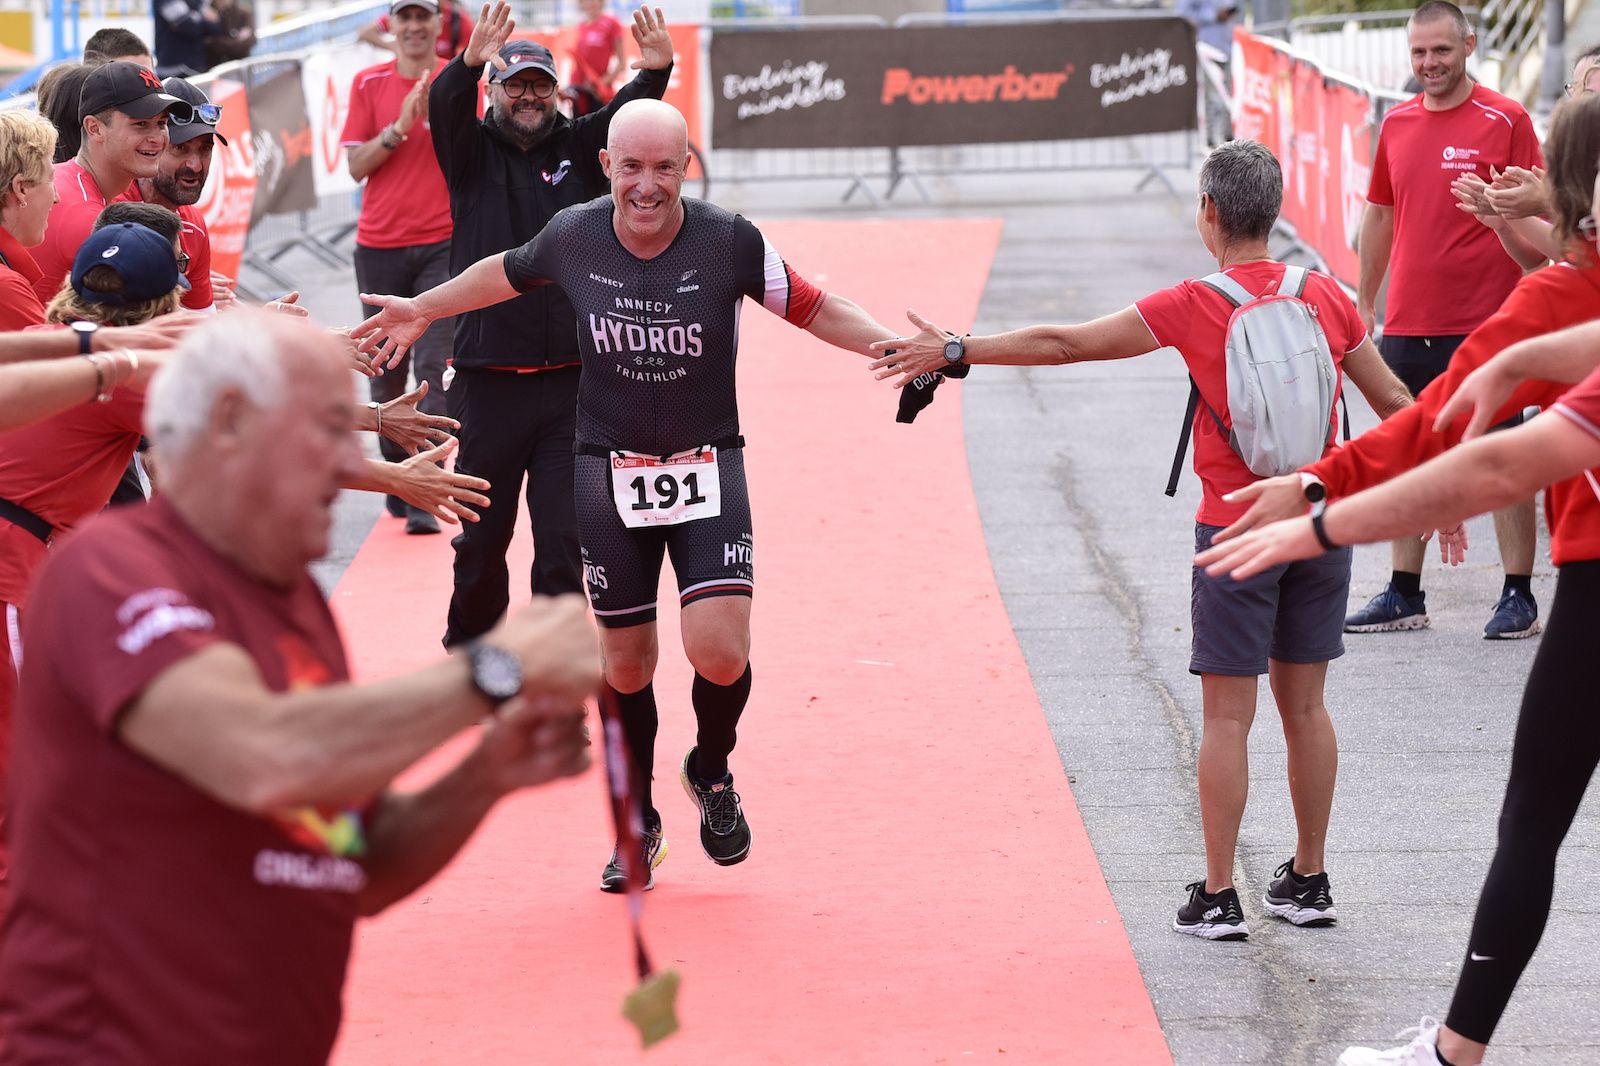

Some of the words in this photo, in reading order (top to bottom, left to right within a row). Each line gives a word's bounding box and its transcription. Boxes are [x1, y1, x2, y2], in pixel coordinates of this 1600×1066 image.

[881, 64, 1068, 105] Powerbar
[1455, 162, 1477, 170] LEADER
[589, 272, 624, 289] ANNECY
[615, 297, 673, 315] ANNECY
[635, 315, 652, 325] LES
[589, 313, 703, 358] HYDROS
[615, 363, 688, 383] TRIATHLON
[630, 472, 706, 511] 191
[1202, 906, 1223, 921] HOKA
